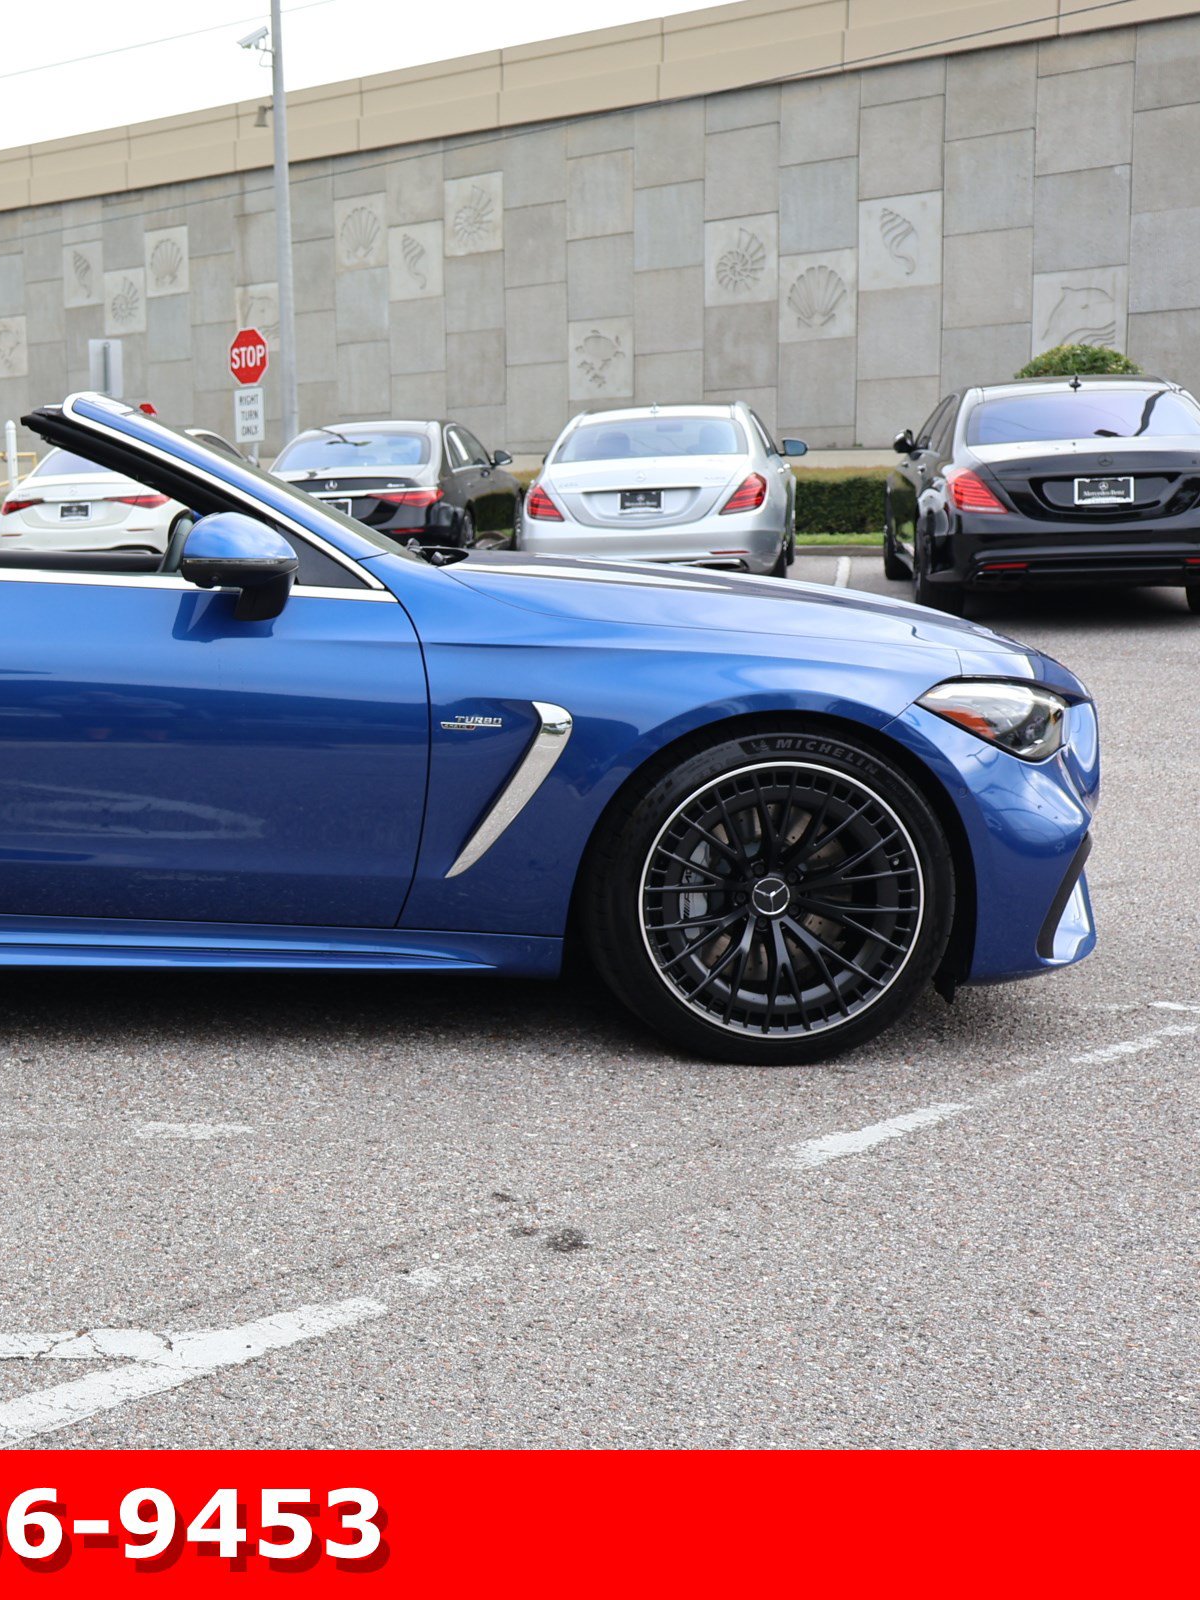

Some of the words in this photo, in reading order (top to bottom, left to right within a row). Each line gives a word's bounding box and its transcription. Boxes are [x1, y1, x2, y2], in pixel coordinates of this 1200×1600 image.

[231, 344, 265, 369] STOP
[239, 394, 259, 406] RIGHT
[241, 409, 259, 421] TURN
[241, 425, 259, 436] ONLY
[454, 715, 502, 725] TURBO
[775, 738, 879, 775] MICHELIN
